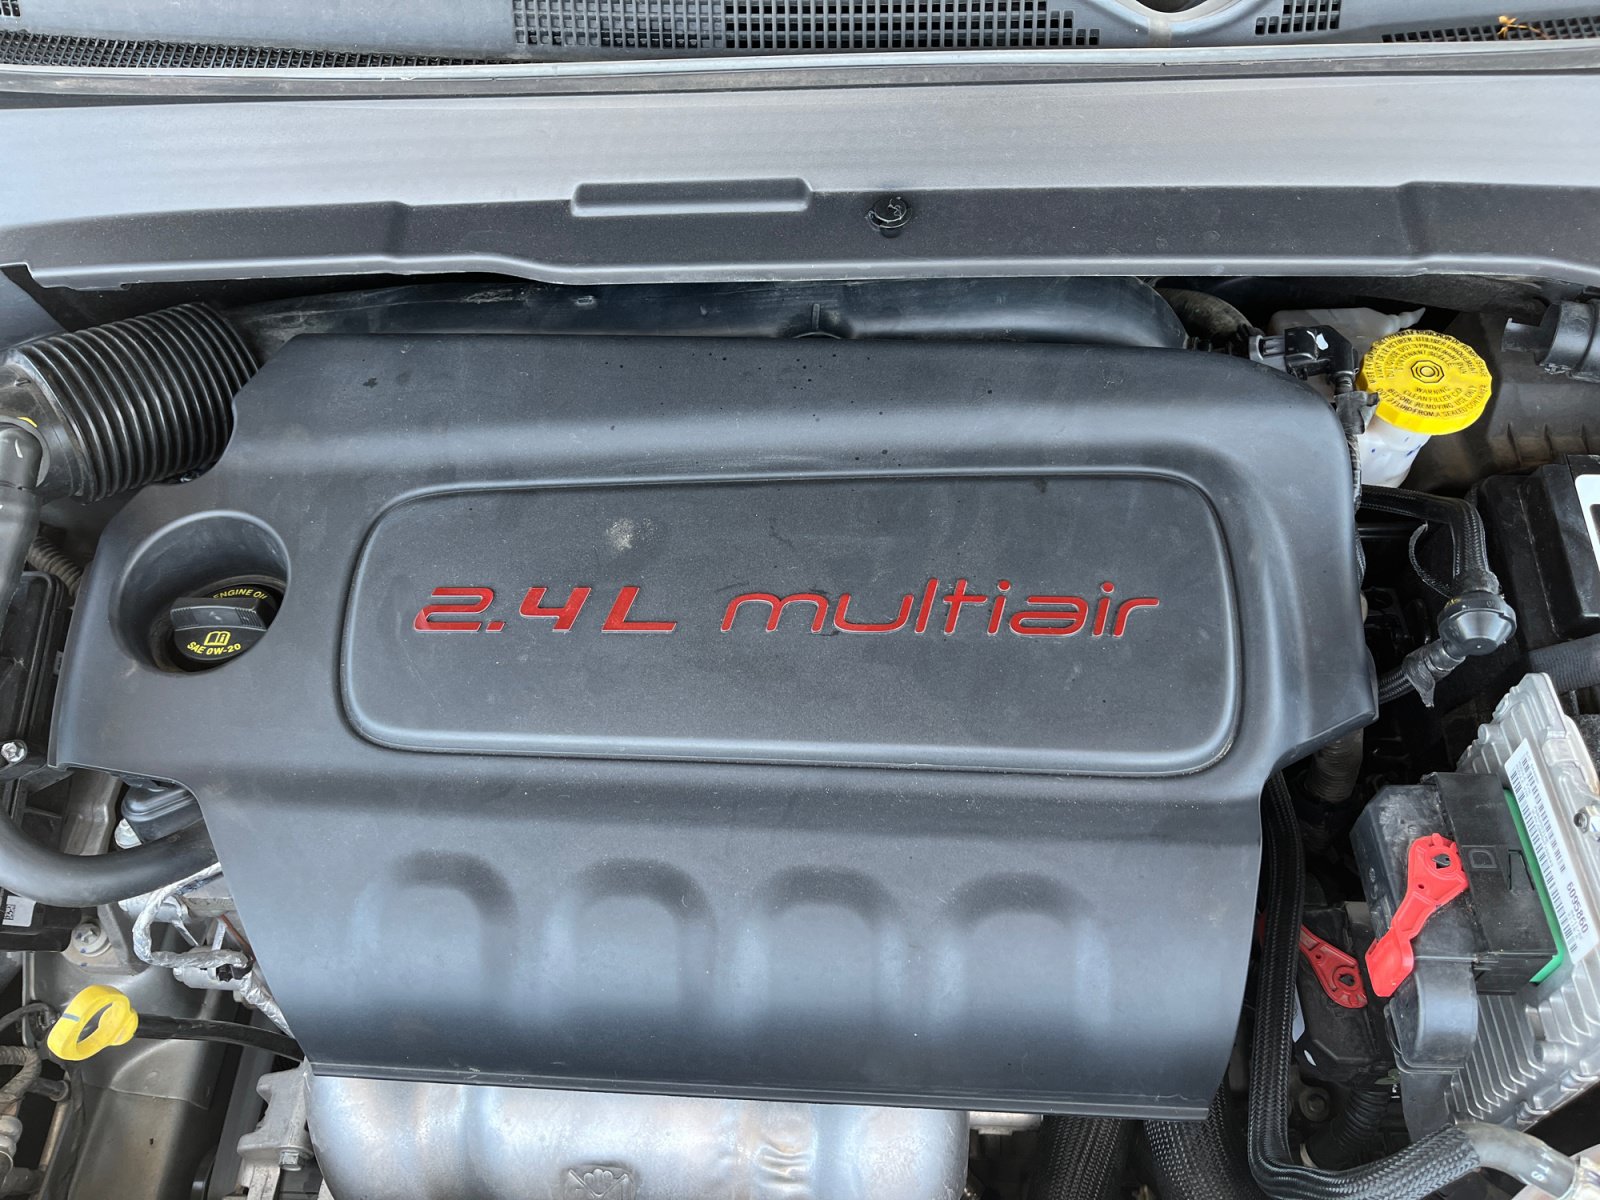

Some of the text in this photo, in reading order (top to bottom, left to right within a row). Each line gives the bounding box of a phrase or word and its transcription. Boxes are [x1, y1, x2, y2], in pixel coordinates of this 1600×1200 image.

[1376, 388, 1389, 398] DOT
[1394, 398, 1414, 411] FLUID
[1412, 406, 1434, 416] FROM
[1387, 387, 1414, 404] BEFORE
[1402, 388, 1427, 401] CLEAN
[213, 588, 254, 598] ENGINE
[719, 578, 1160, 637] multiair
[187, 641, 206, 654] SAE
[1566, 881, 1589, 934] 6095860
